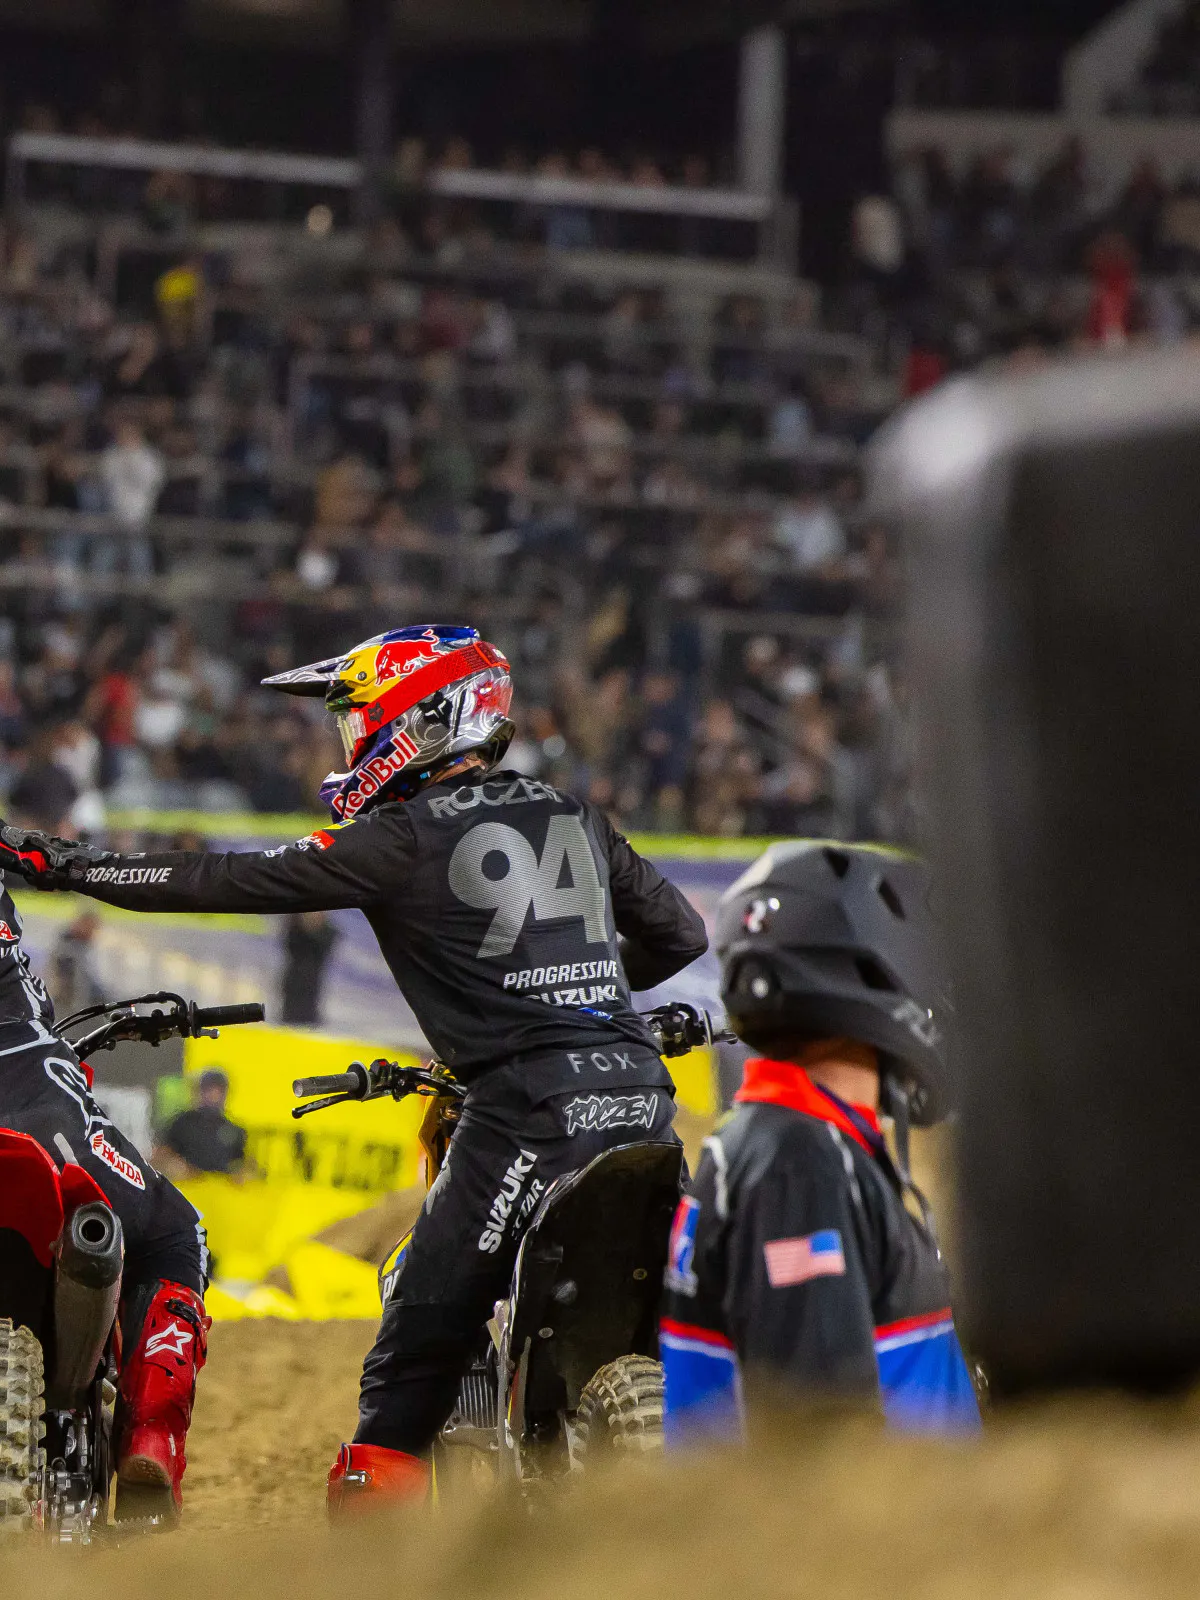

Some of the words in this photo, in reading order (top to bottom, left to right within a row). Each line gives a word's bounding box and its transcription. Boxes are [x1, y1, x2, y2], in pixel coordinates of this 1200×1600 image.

[448, 815, 618, 958] 94
[503, 960, 618, 990] PROGRESSIVE
[566, 1052, 638, 1074] FOX
[563, 1093, 658, 1135] ROCZEN
[479, 1149, 538, 1254] SUZUKI
